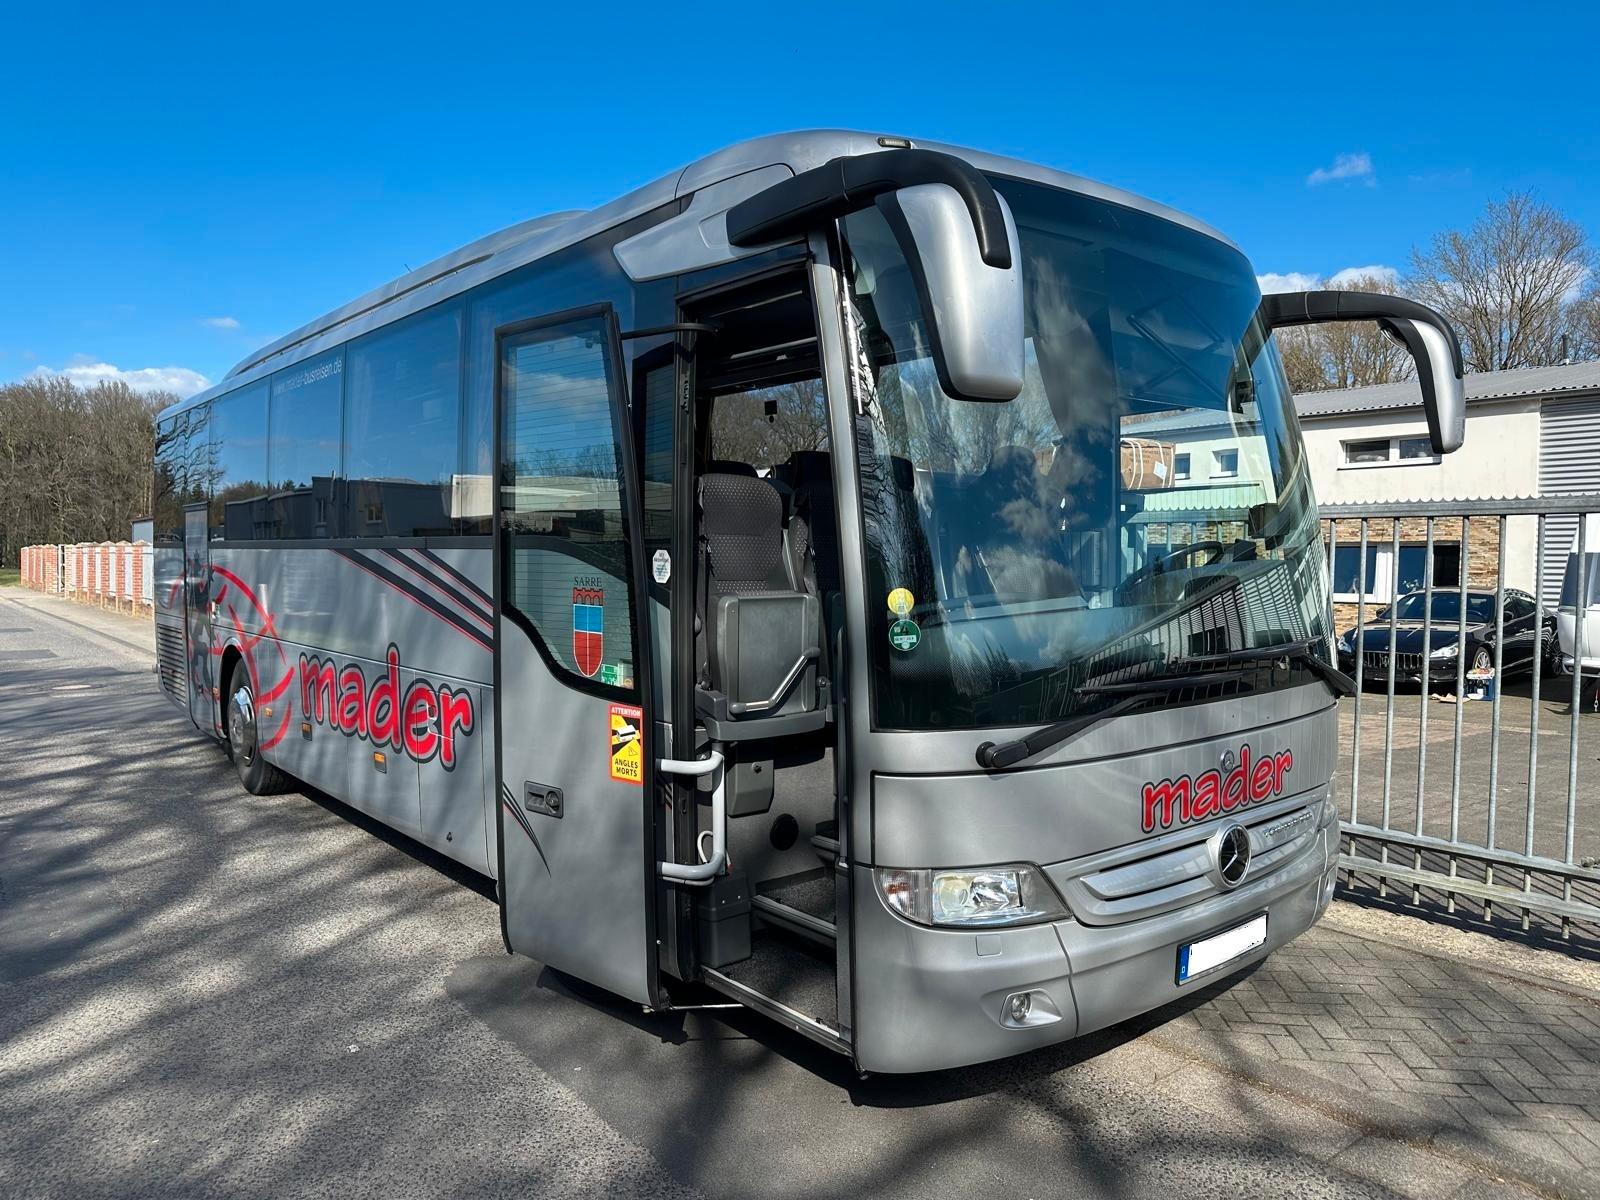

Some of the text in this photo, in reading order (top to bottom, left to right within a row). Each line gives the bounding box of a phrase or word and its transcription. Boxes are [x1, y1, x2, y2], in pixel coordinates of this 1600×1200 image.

[574, 576, 602, 587] SARRE
[299, 642, 475, 772] mader
[611, 706, 641, 717] ATTENTION
[615, 758, 638, 769] ANGLES
[616, 766, 637, 777] MORTS
[1141, 743, 1292, 834] mader
